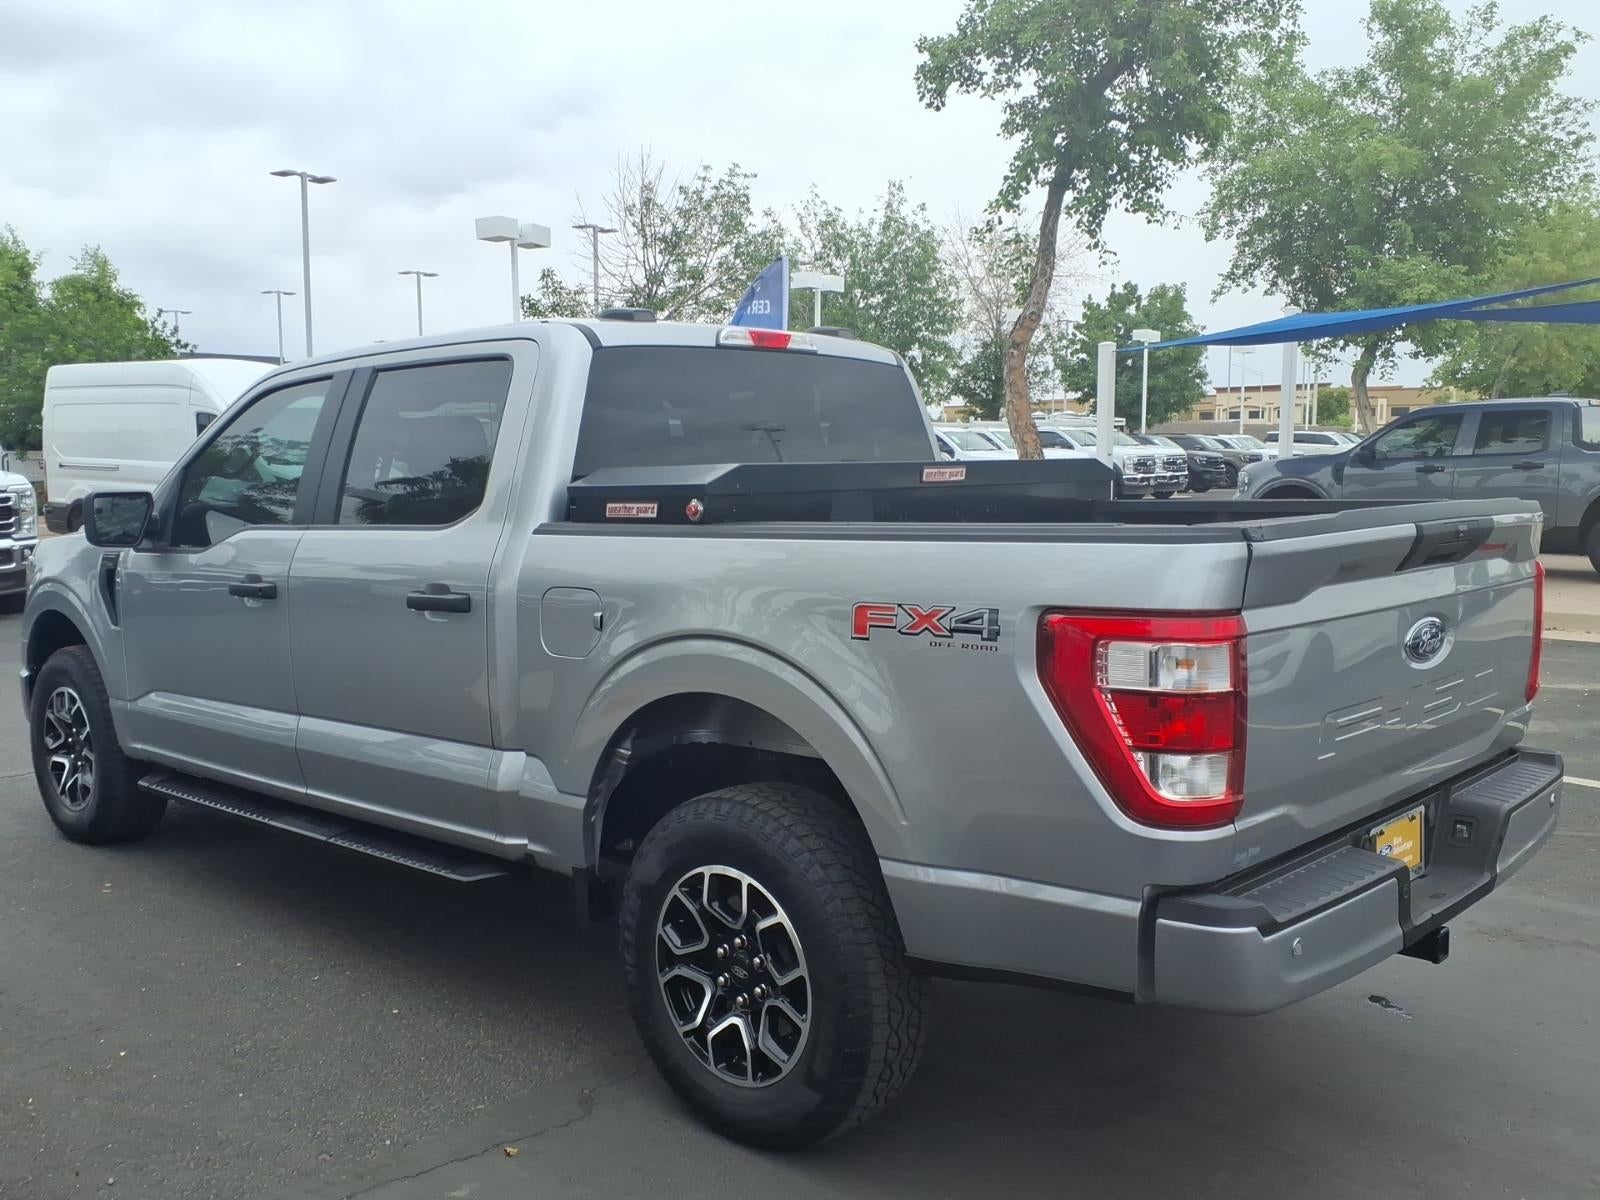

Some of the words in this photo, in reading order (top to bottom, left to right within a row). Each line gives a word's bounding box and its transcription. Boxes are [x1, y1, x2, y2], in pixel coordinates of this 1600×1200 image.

[636, 504, 655, 516] guard
[851, 602, 1000, 642] FX4
[961, 643, 998, 652] ROAD
